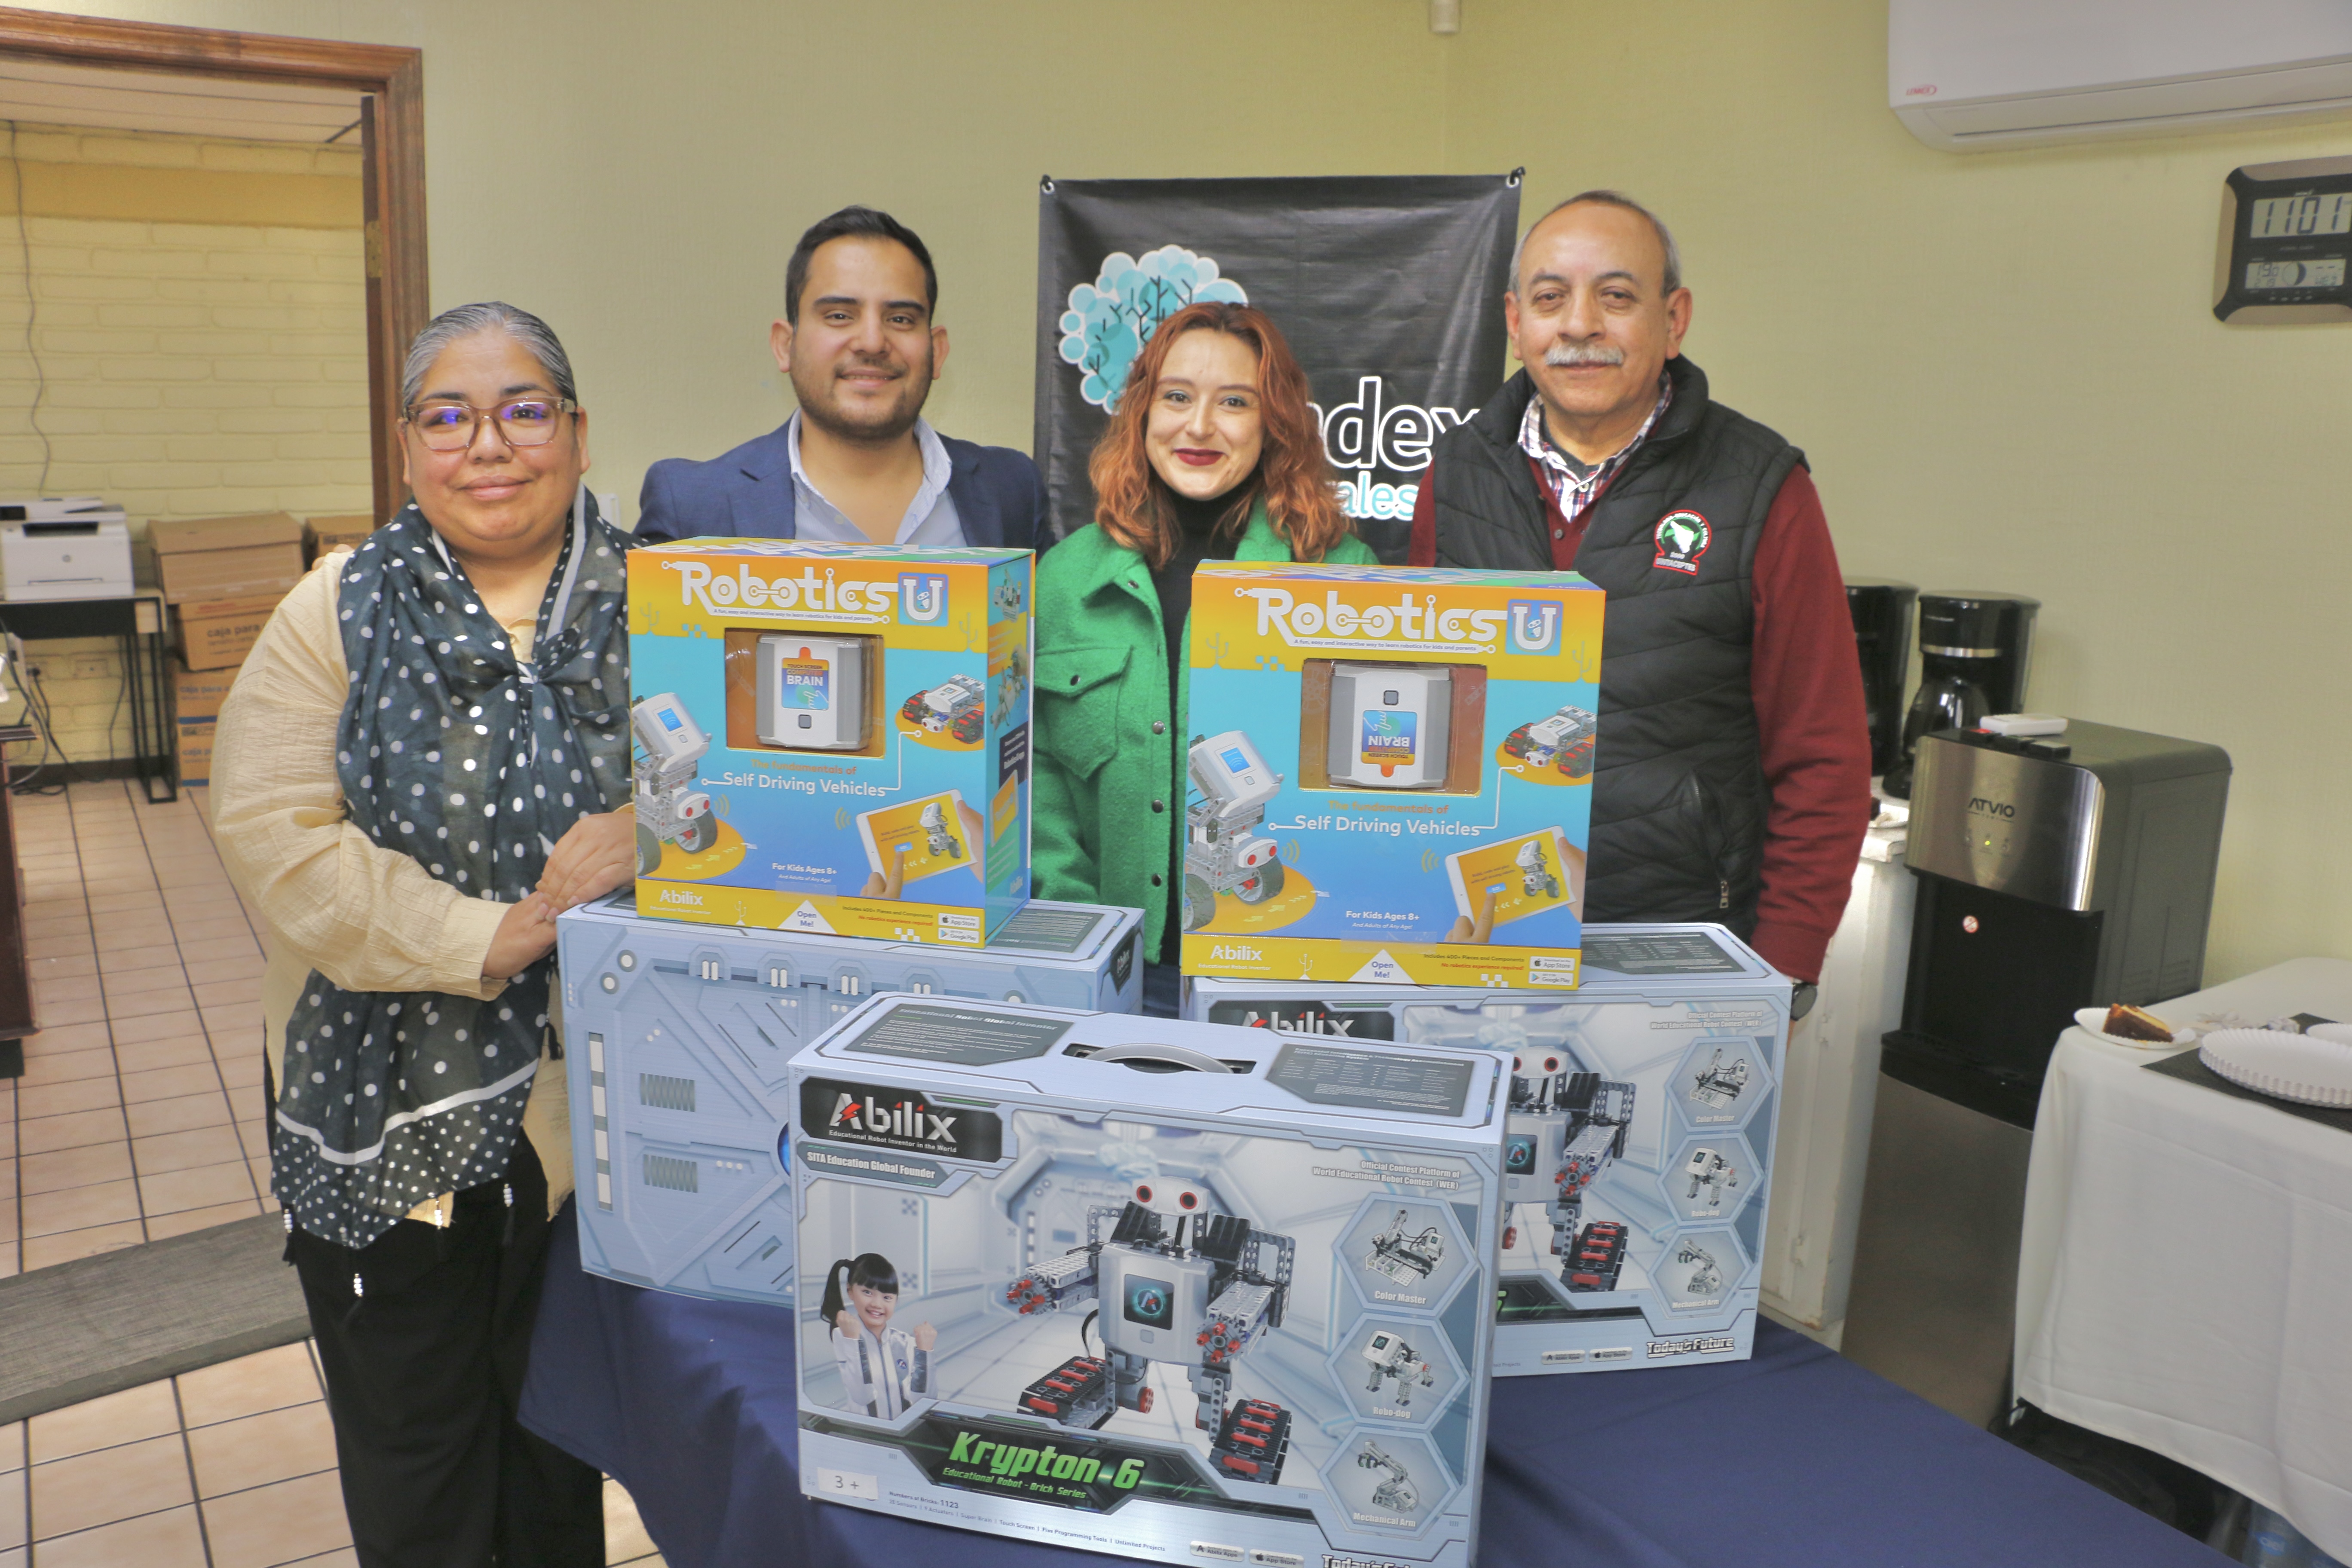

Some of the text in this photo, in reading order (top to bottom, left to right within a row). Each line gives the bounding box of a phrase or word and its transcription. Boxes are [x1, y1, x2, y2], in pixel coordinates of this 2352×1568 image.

[662, 560, 943, 621] Robotics U
[1234, 588, 1556, 650] Robotics U
[787, 675, 823, 686] BRAIN
[1368, 735, 1410, 747] BRAIN
[751, 759, 857, 775] The fundamentals of
[723, 772, 886, 796] Self Driving Vehicles
[1328, 800, 1449, 814] The fundamentals of
[1969, 798, 2015, 818] ATVIO
[1295, 815, 1481, 837] Self Driving Vehicles
[787, 864, 805, 872] Kids
[806, 866, 825, 875] Ages
[660, 889, 703, 906] Abilix
[797, 911, 816, 919] Open
[1346, 910, 1362, 919] For
[1363, 911, 1382, 920] Kids
[1385, 912, 1406, 921] Ages
[1210, 945, 1262, 961] Abilix
[1371, 961, 1393, 970] Open
[898, 1009, 955, 1018] Educational
[1015, 1021, 1058, 1030] Inventor
[1242, 1011, 1354, 1037] Abilix
[829, 1093, 957, 1143] Abilix
[829, 1130, 867, 1140] Educational
[888, 1138, 916, 1147] Inventor
[807, 1152, 936, 1179] SITA Education Global Founder
[1361, 1161, 1388, 1170] Official
[1389, 1163, 1418, 1173] Contest
[1419, 1167, 1451, 1177] Platform
[1313, 1167, 1459, 1190] World Educational Robot Contest (WER)
[1691, 1209, 1720, 1218] Robo-dog
[1375, 1290, 1427, 1304] Color Master
[1672, 1300, 1707, 1309] Mechanical
[1647, 1337, 1734, 1354] Today's Future
[1373, 1406, 1411, 1418] Robo-dog
[949, 1431, 1145, 1489] Krypton 6
[942, 1467, 1087, 1499] Educational Robot Brick Series
[889, 1491, 913, 1500] Numbers
[940, 1500, 959, 1509] 1123
[897, 1501, 917, 1509] Sensors
[929, 1507, 954, 1516] Actuators
[1055, 1529, 1092, 1540] Programming
[1115, 1539, 1142, 1547] Unlimited
[1143, 1543, 1166, 1551] Projects
[1354, 1513, 1416, 1527] Mechanical Arm
